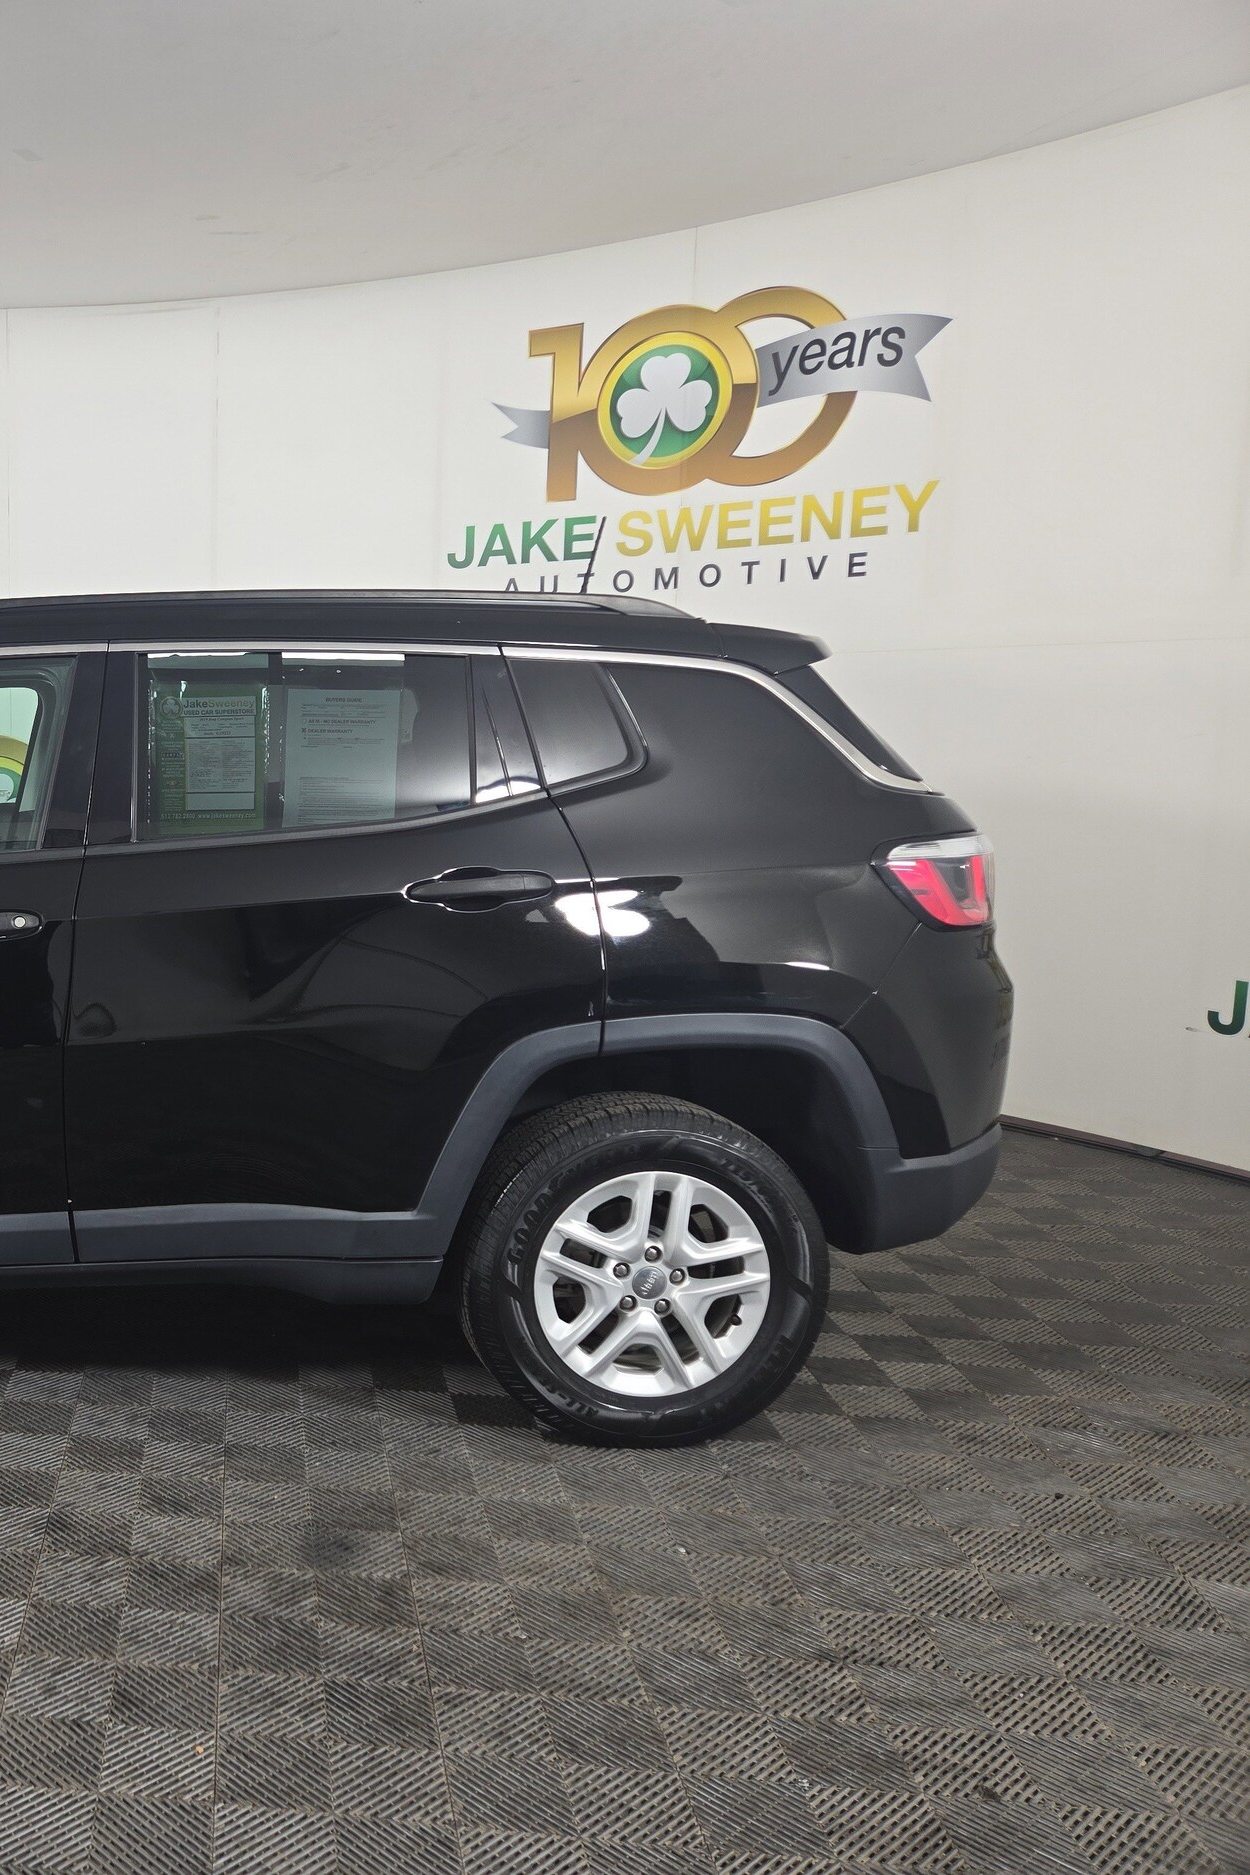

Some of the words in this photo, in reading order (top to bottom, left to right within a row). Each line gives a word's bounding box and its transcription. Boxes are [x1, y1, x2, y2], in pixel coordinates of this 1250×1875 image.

[528, 286, 858, 502] 100
[768, 326, 906, 397] years
[447, 515, 598, 570] JAKE
[615, 480, 940, 558] SWEENEY
